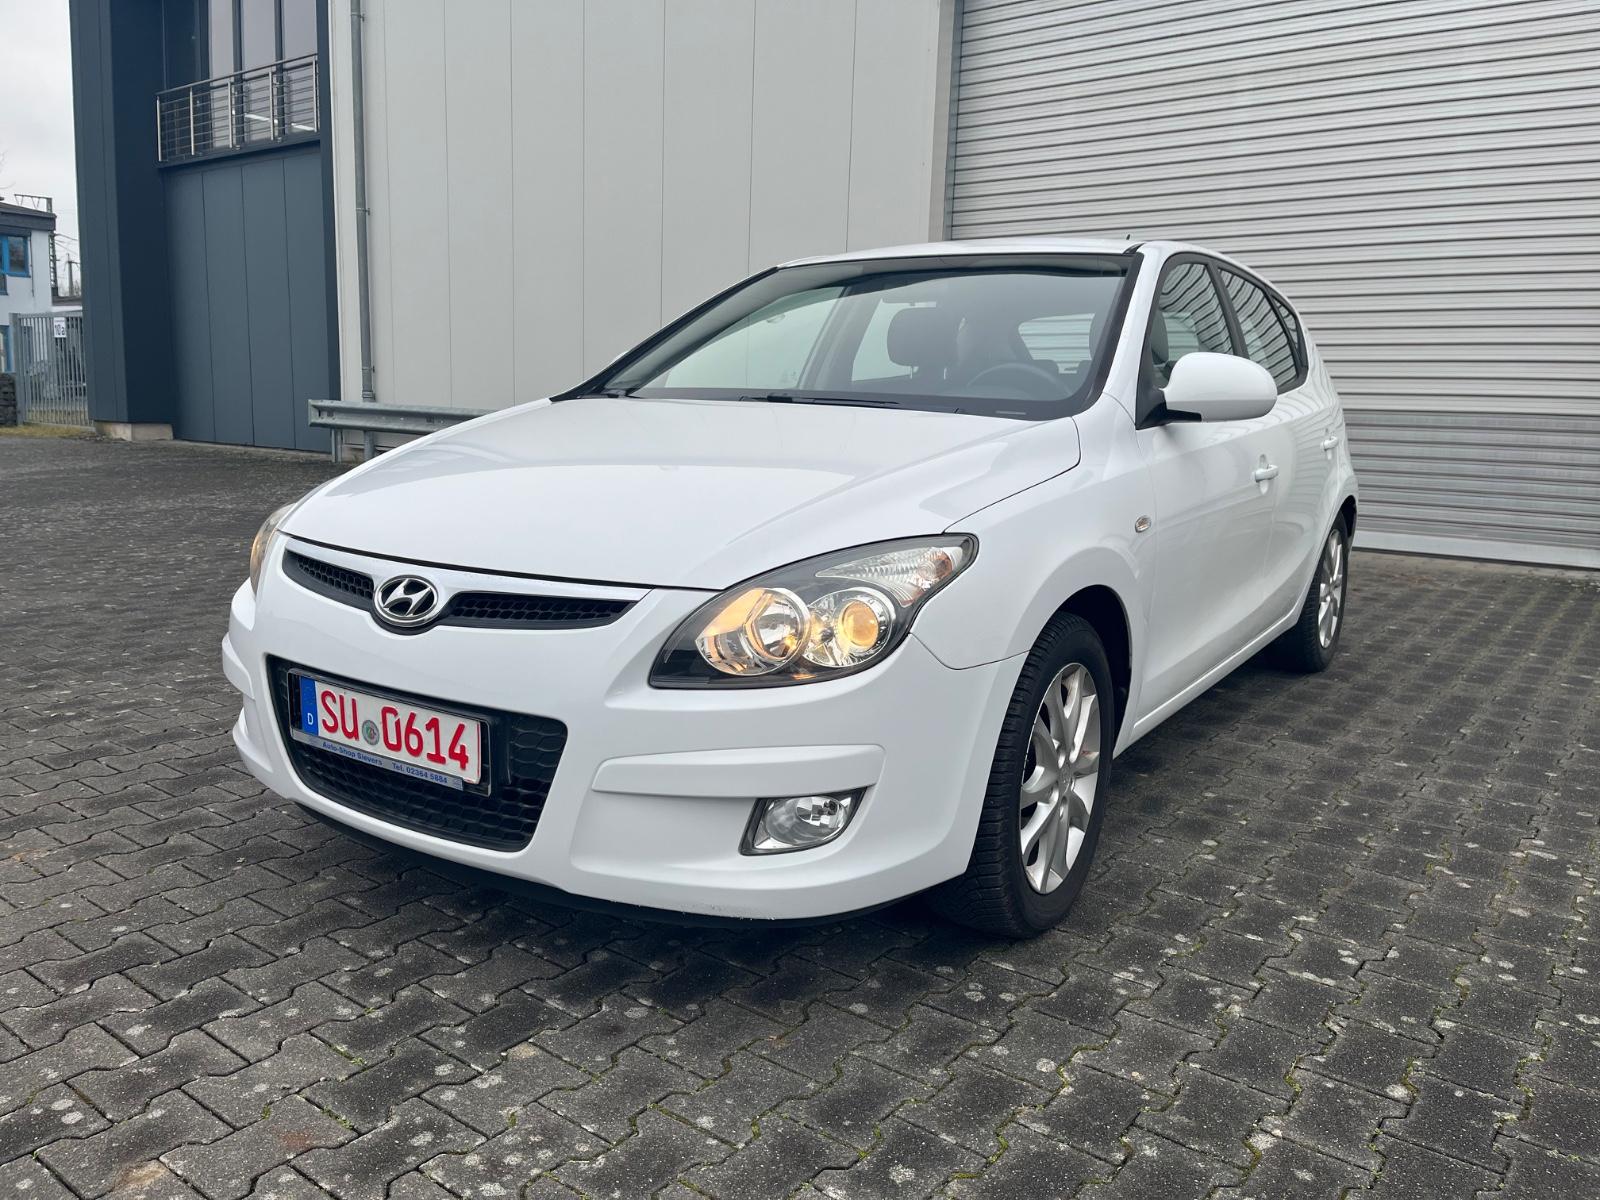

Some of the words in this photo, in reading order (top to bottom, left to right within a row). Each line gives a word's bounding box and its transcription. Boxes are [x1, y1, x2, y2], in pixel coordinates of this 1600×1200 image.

[307, 712, 314, 725] D
[320, 690, 360, 741] SU
[380, 706, 469, 771] 0614
[357, 752, 383, 766] Sievers
[392, 761, 405, 772] Tel.
